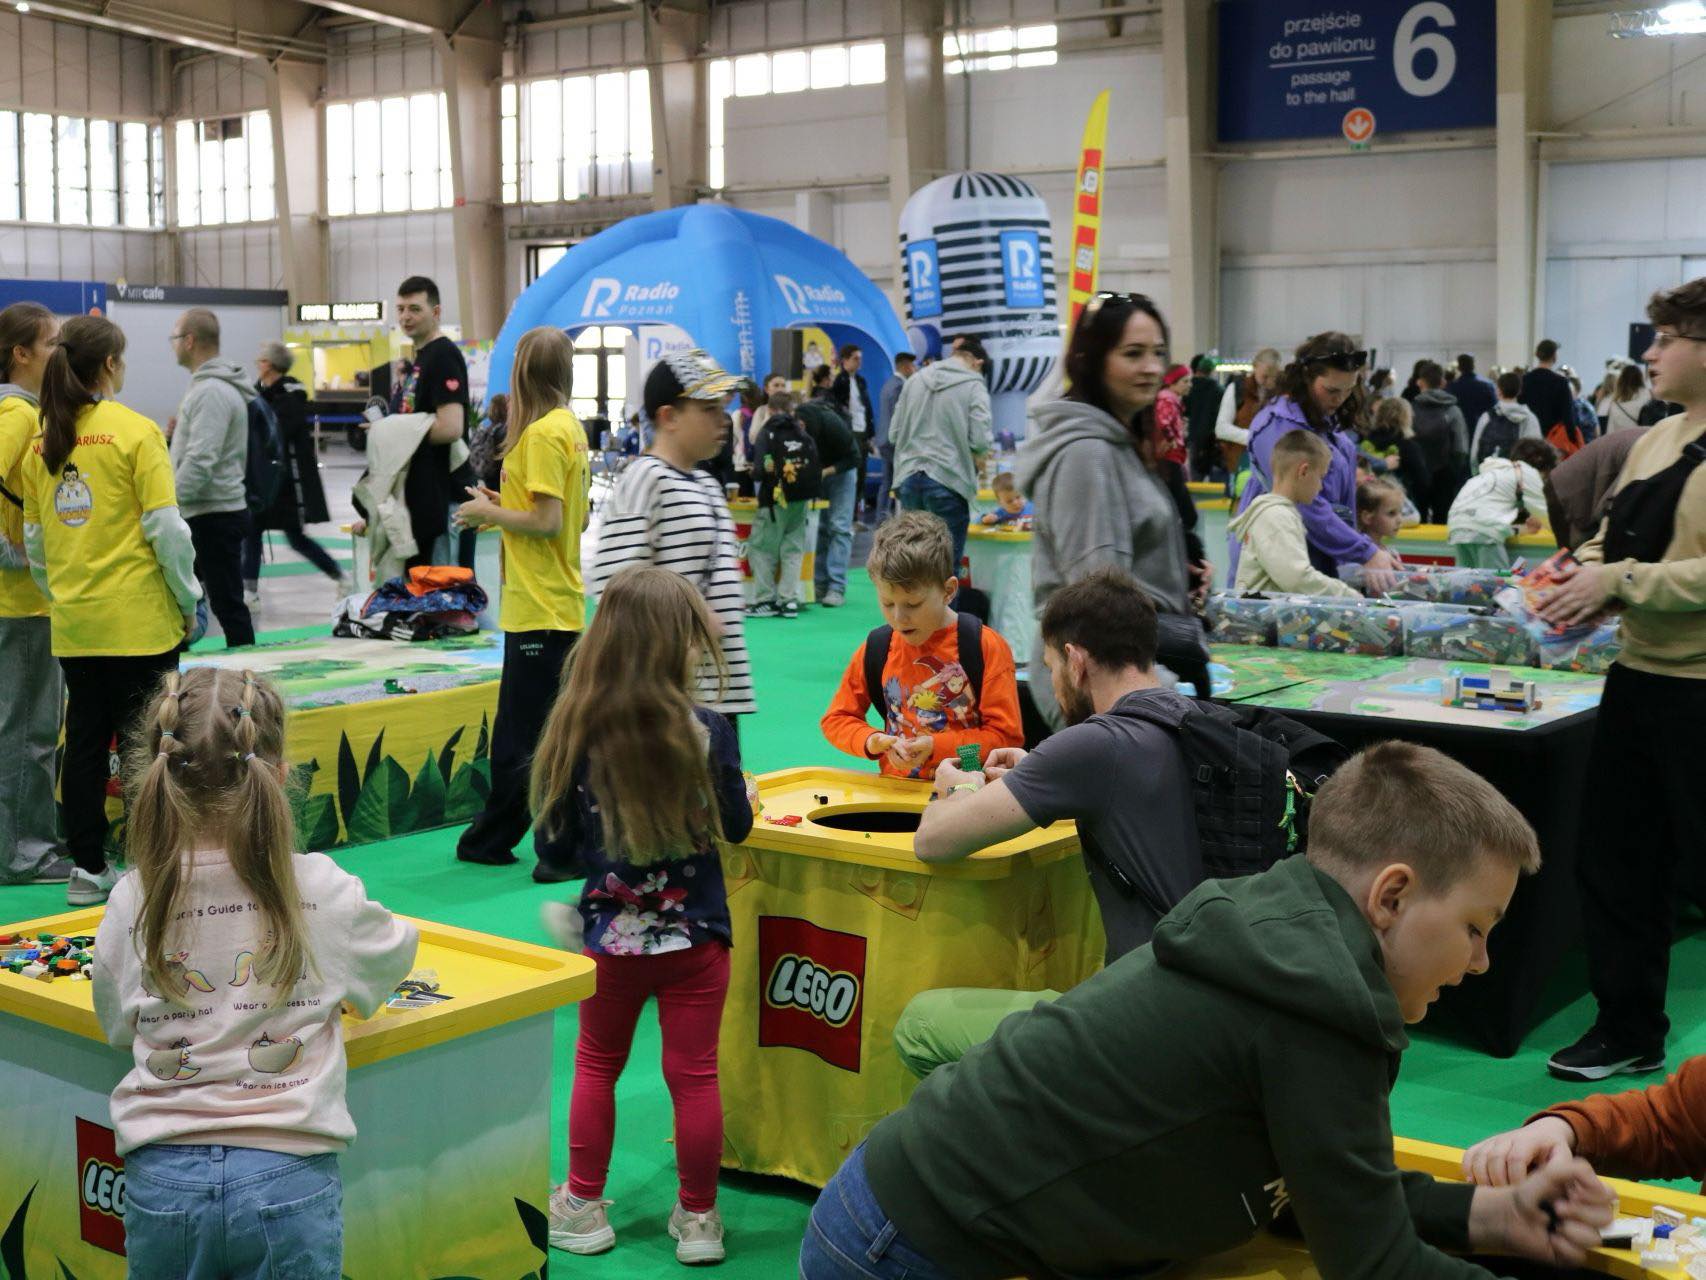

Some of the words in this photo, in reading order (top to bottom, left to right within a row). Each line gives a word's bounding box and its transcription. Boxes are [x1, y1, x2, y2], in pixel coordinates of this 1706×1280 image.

[1284, 12, 1362, 37] przejście
[1269, 41, 1291, 59] do
[1297, 37, 1375, 59] pawilonu
[1393, 1, 1456, 97] 6
[1291, 69, 1351, 88] passage
[1286, 92, 1301, 105] to
[1304, 90, 1327, 104] the
[1330, 88, 1355, 103] hall
[625, 281, 680, 301] Radio
[803, 285, 845, 302] Radio
[207, 902, 243, 916] Guide
[769, 956, 857, 1024] LEGO
[234, 1001, 258, 1011] Wear
[308, 999, 321, 1007] hat
[140, 1013, 160, 1024] Wear
[172, 1010, 196, 1020] party
[235, 1079, 258, 1090] Wear
[274, 1080, 287, 1089] ice
[289, 1076, 309, 1086] cream
